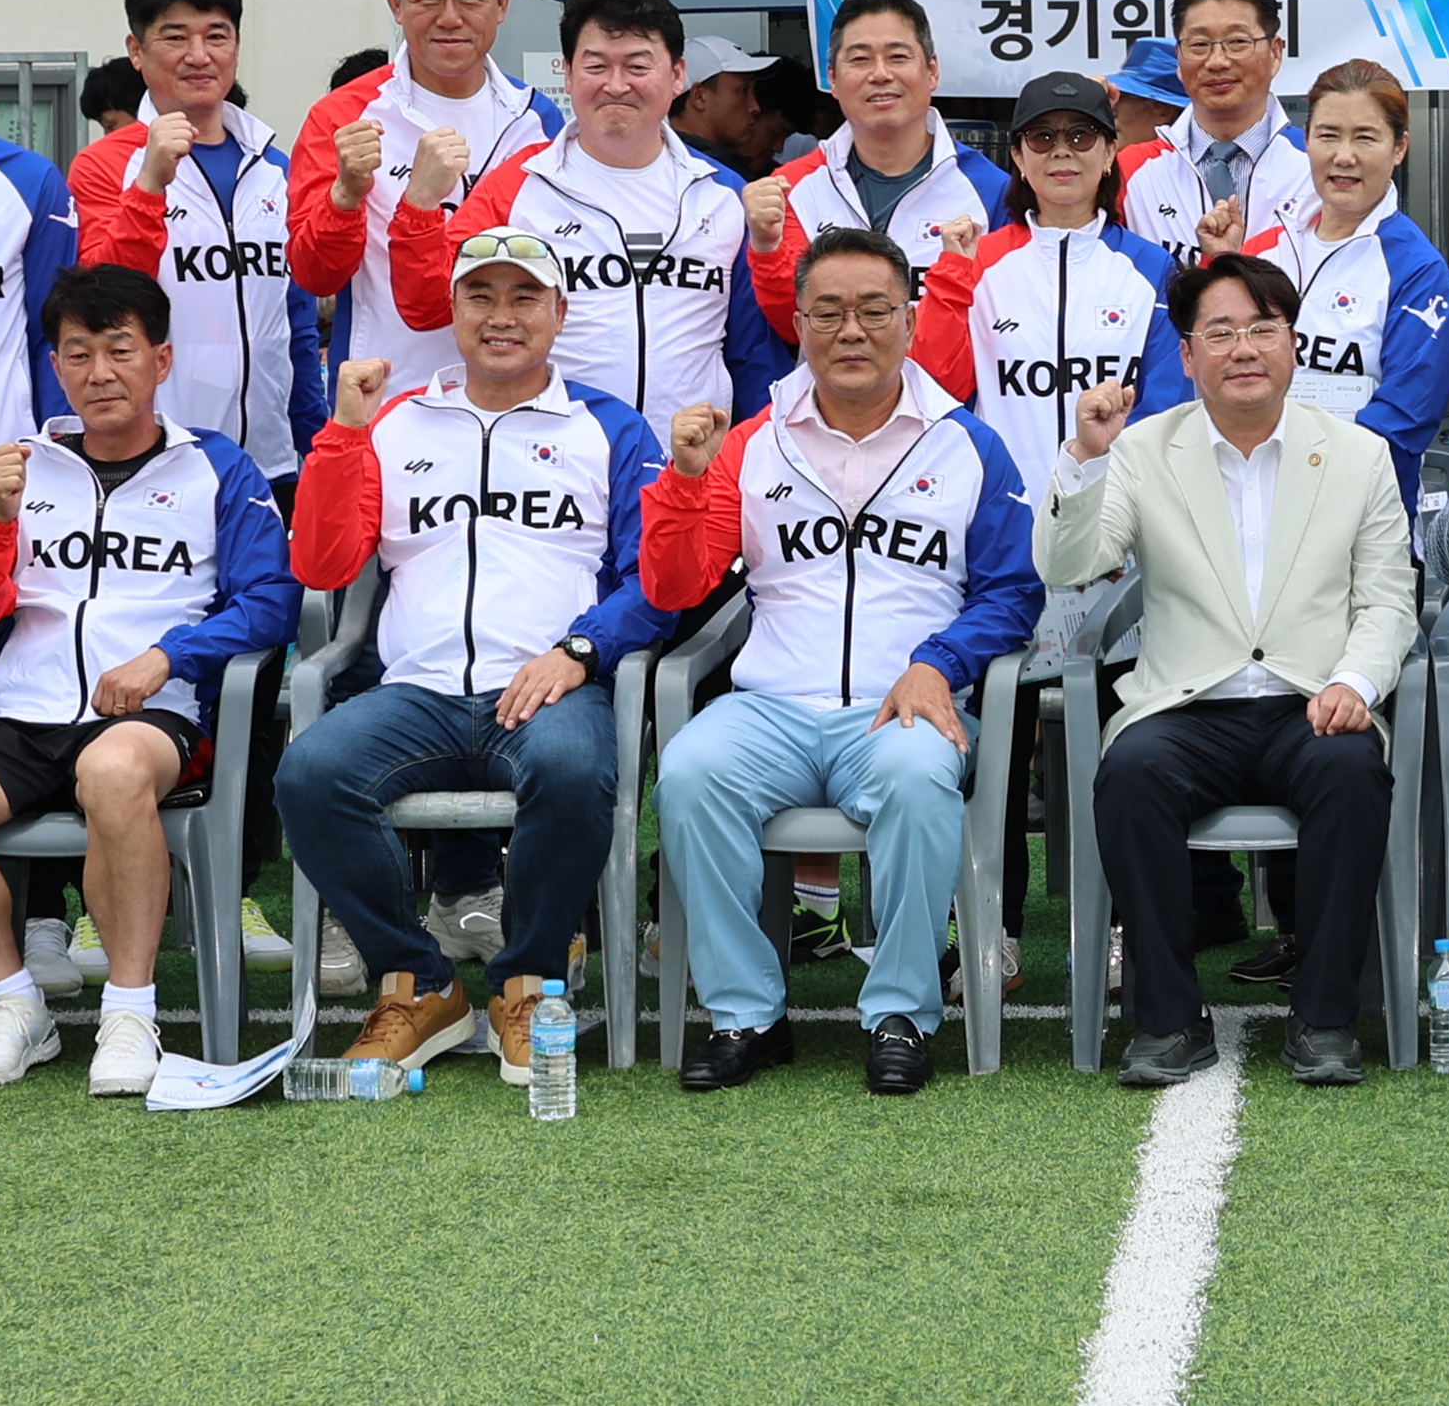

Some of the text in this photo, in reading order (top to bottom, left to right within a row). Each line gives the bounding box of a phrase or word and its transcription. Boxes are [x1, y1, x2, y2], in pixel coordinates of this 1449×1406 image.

[173, 241, 289, 283] KORE
[564, 254, 725, 295] KOREA
[1296, 332, 1365, 376] REA
[409, 490, 585, 536] KOREA
[29, 531, 194, 576] KOREA
[777, 512, 949, 571] KOREA
